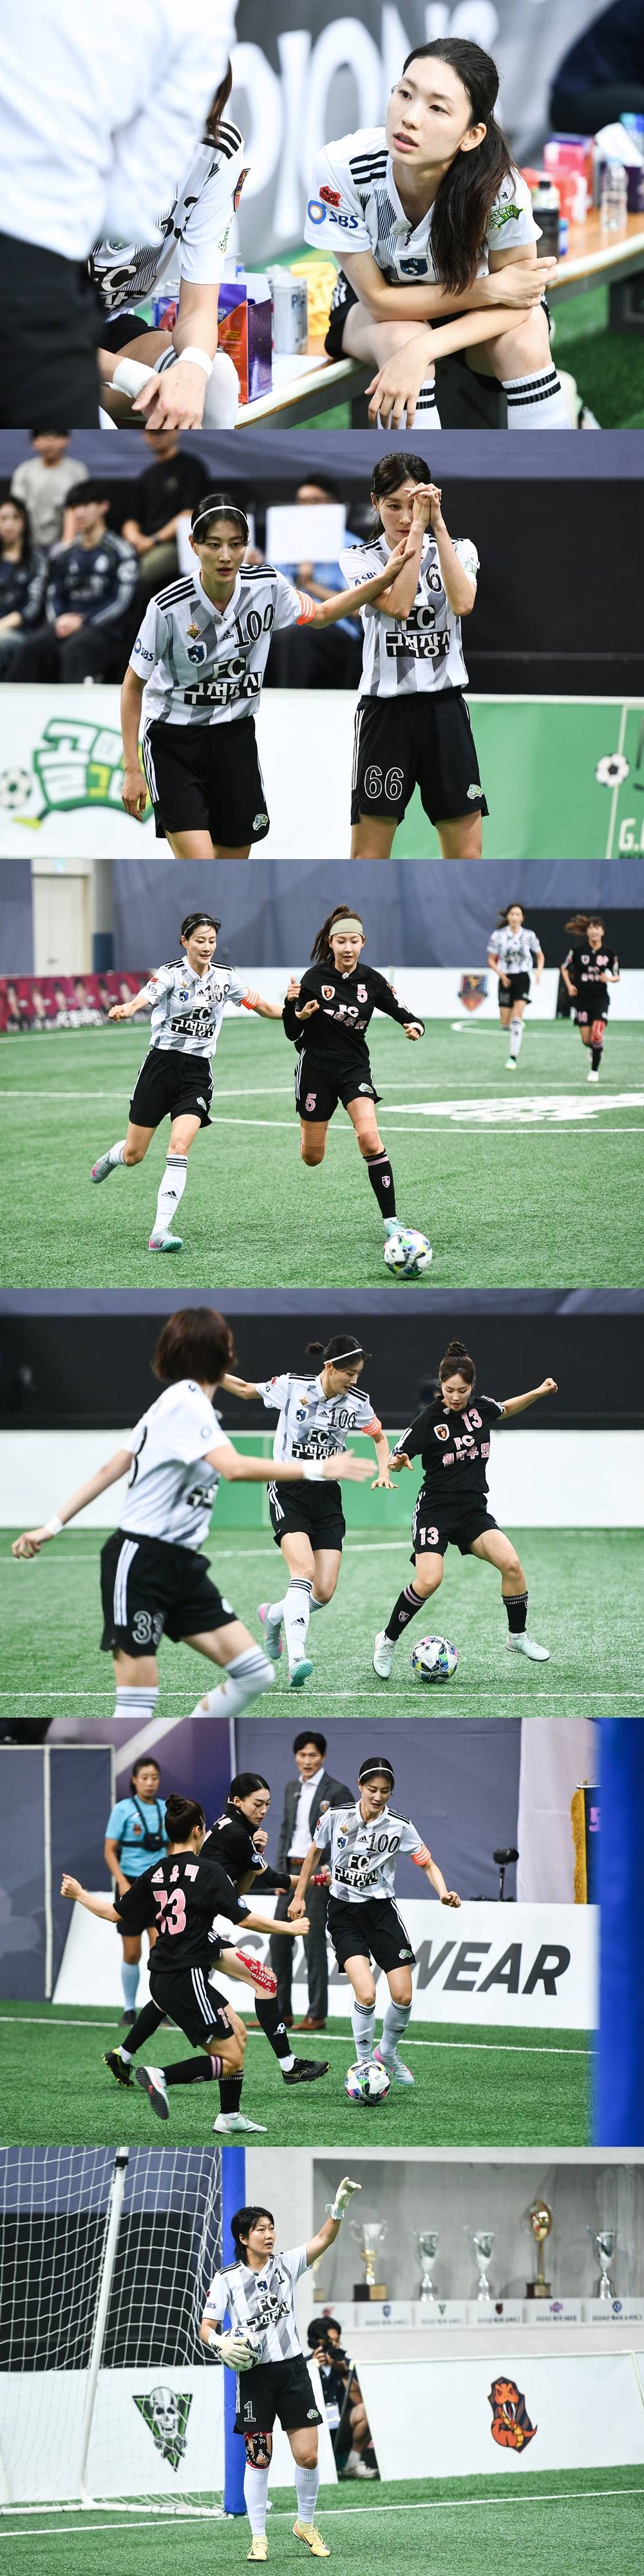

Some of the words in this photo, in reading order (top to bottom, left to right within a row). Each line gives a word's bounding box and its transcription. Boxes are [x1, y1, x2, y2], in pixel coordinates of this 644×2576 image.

[322, 188, 337, 200] PRISM
[328, 210, 359, 229] SBS
[426, 563, 442, 592] 6
[232, 603, 276, 650] 100
[401, 606, 435, 631] FC
[140, 647, 155, 662] SBS
[212, 657, 246, 680] FC
[364, 765, 404, 800] 66
[618, 817, 644, 852] G.
[357, 983, 368, 1003] 5
[189, 1007, 212, 1021] FC
[305, 1092, 317, 1112] 5
[461, 1408, 483, 1432] 13
[307, 1428, 331, 1444] FC
[453, 1435, 475, 1451] FC
[419, 1526, 439, 1546] 13
[366, 1832, 401, 1854] 100
[347, 1854, 371, 1870] FC
[335, 1866, 378, 1888] 구척장신
[274, 2267, 285, 2285] 1
[256, 2294, 279, 2314] FC
[244, 2401, 256, 2422] 1
